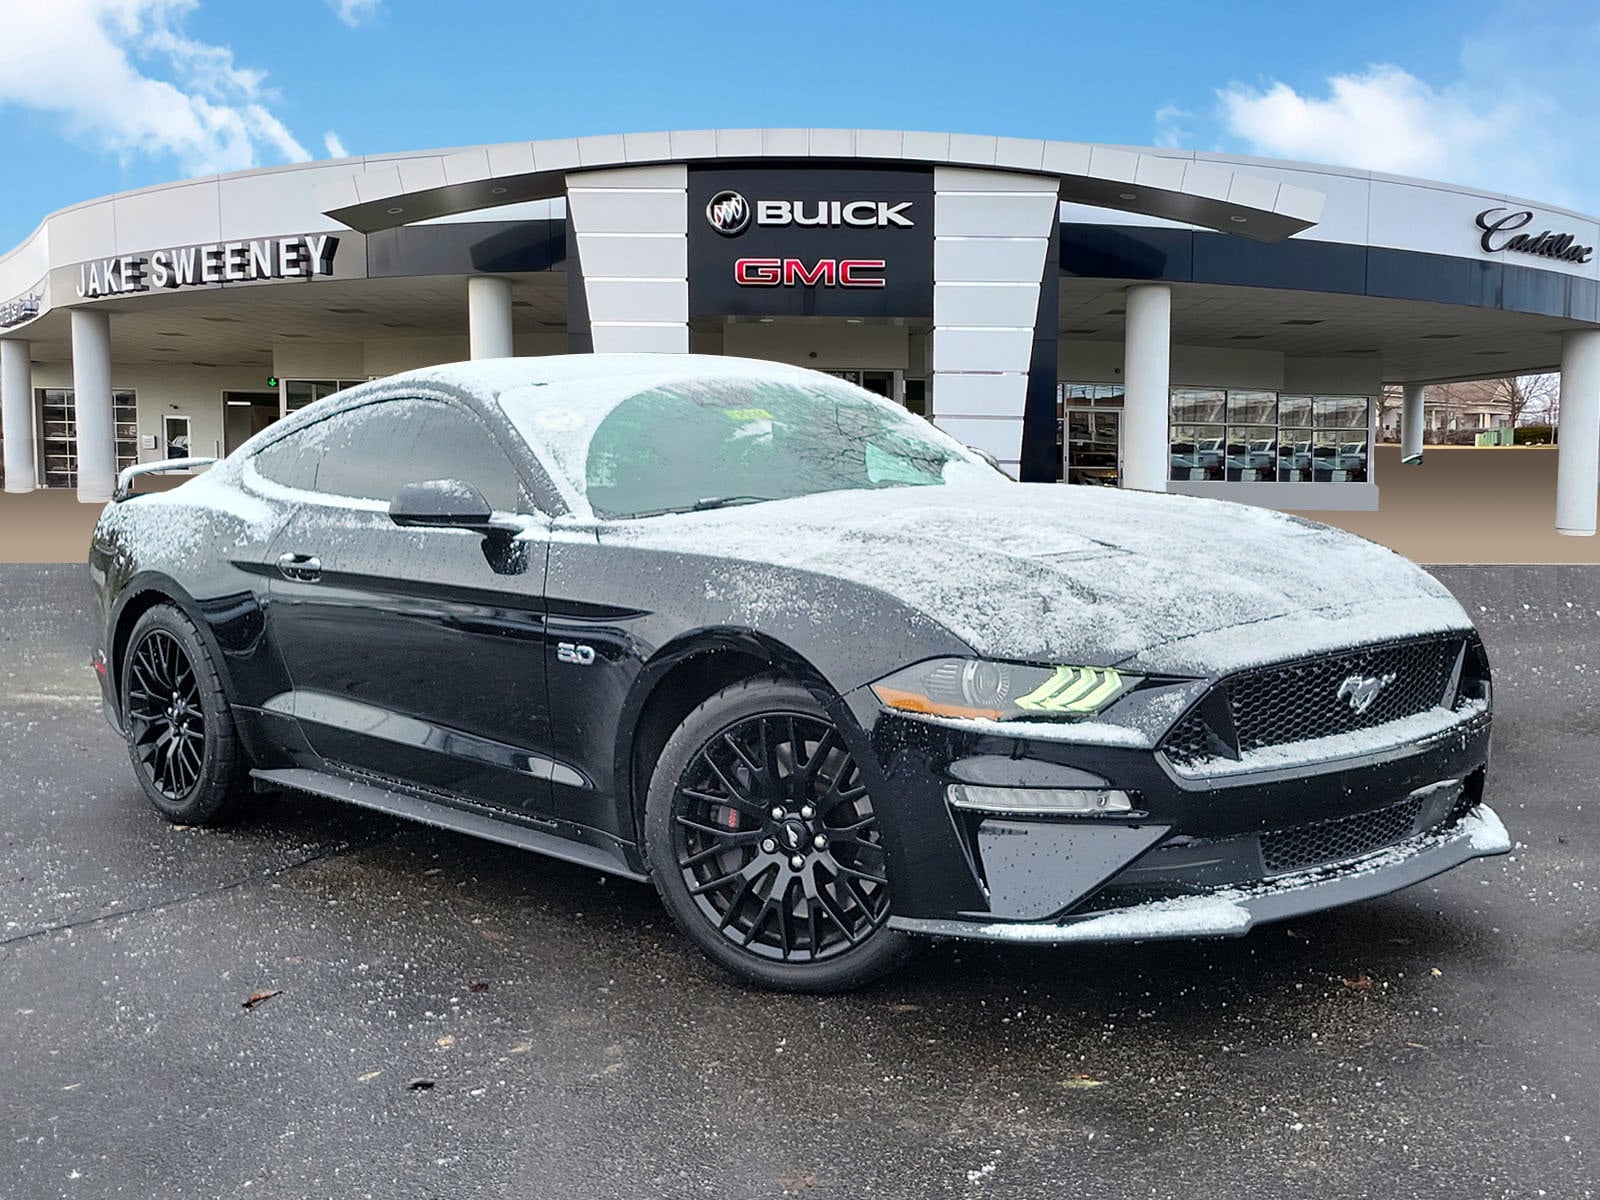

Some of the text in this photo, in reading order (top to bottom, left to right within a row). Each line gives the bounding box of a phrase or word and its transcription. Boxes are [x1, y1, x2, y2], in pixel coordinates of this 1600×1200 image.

[756, 200, 915, 226] BUICK
[1475, 207, 1594, 264] Cadillac
[76, 235, 335, 298] JAKE SWEENEY
[735, 258, 886, 287] GMC
